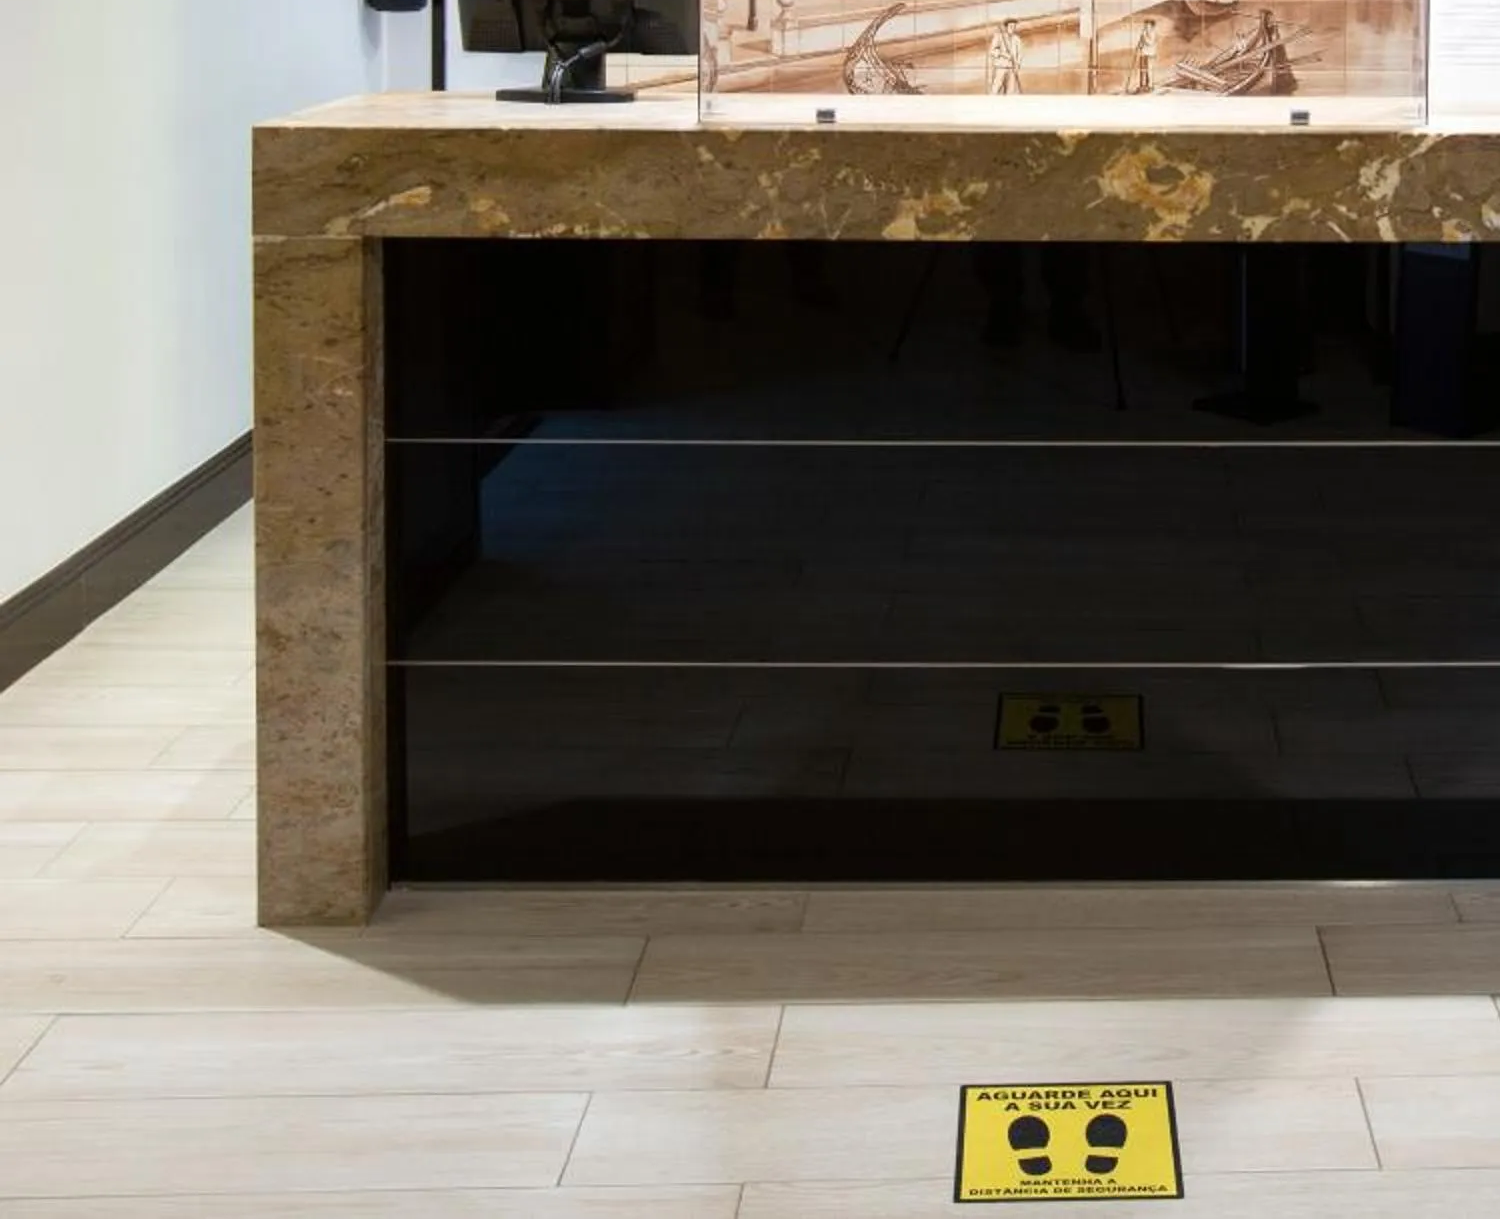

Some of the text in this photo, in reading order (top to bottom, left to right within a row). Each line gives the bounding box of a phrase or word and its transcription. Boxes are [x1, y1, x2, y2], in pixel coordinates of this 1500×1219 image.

[976, 1088, 1158, 1101] AGUARDE AQUI
[1004, 1100, 1132, 1112] A SUA VEZ
[1020, 1178, 1103, 1186] MANTENHA
[1077, 1184, 1169, 1194] SEGURANÇA
